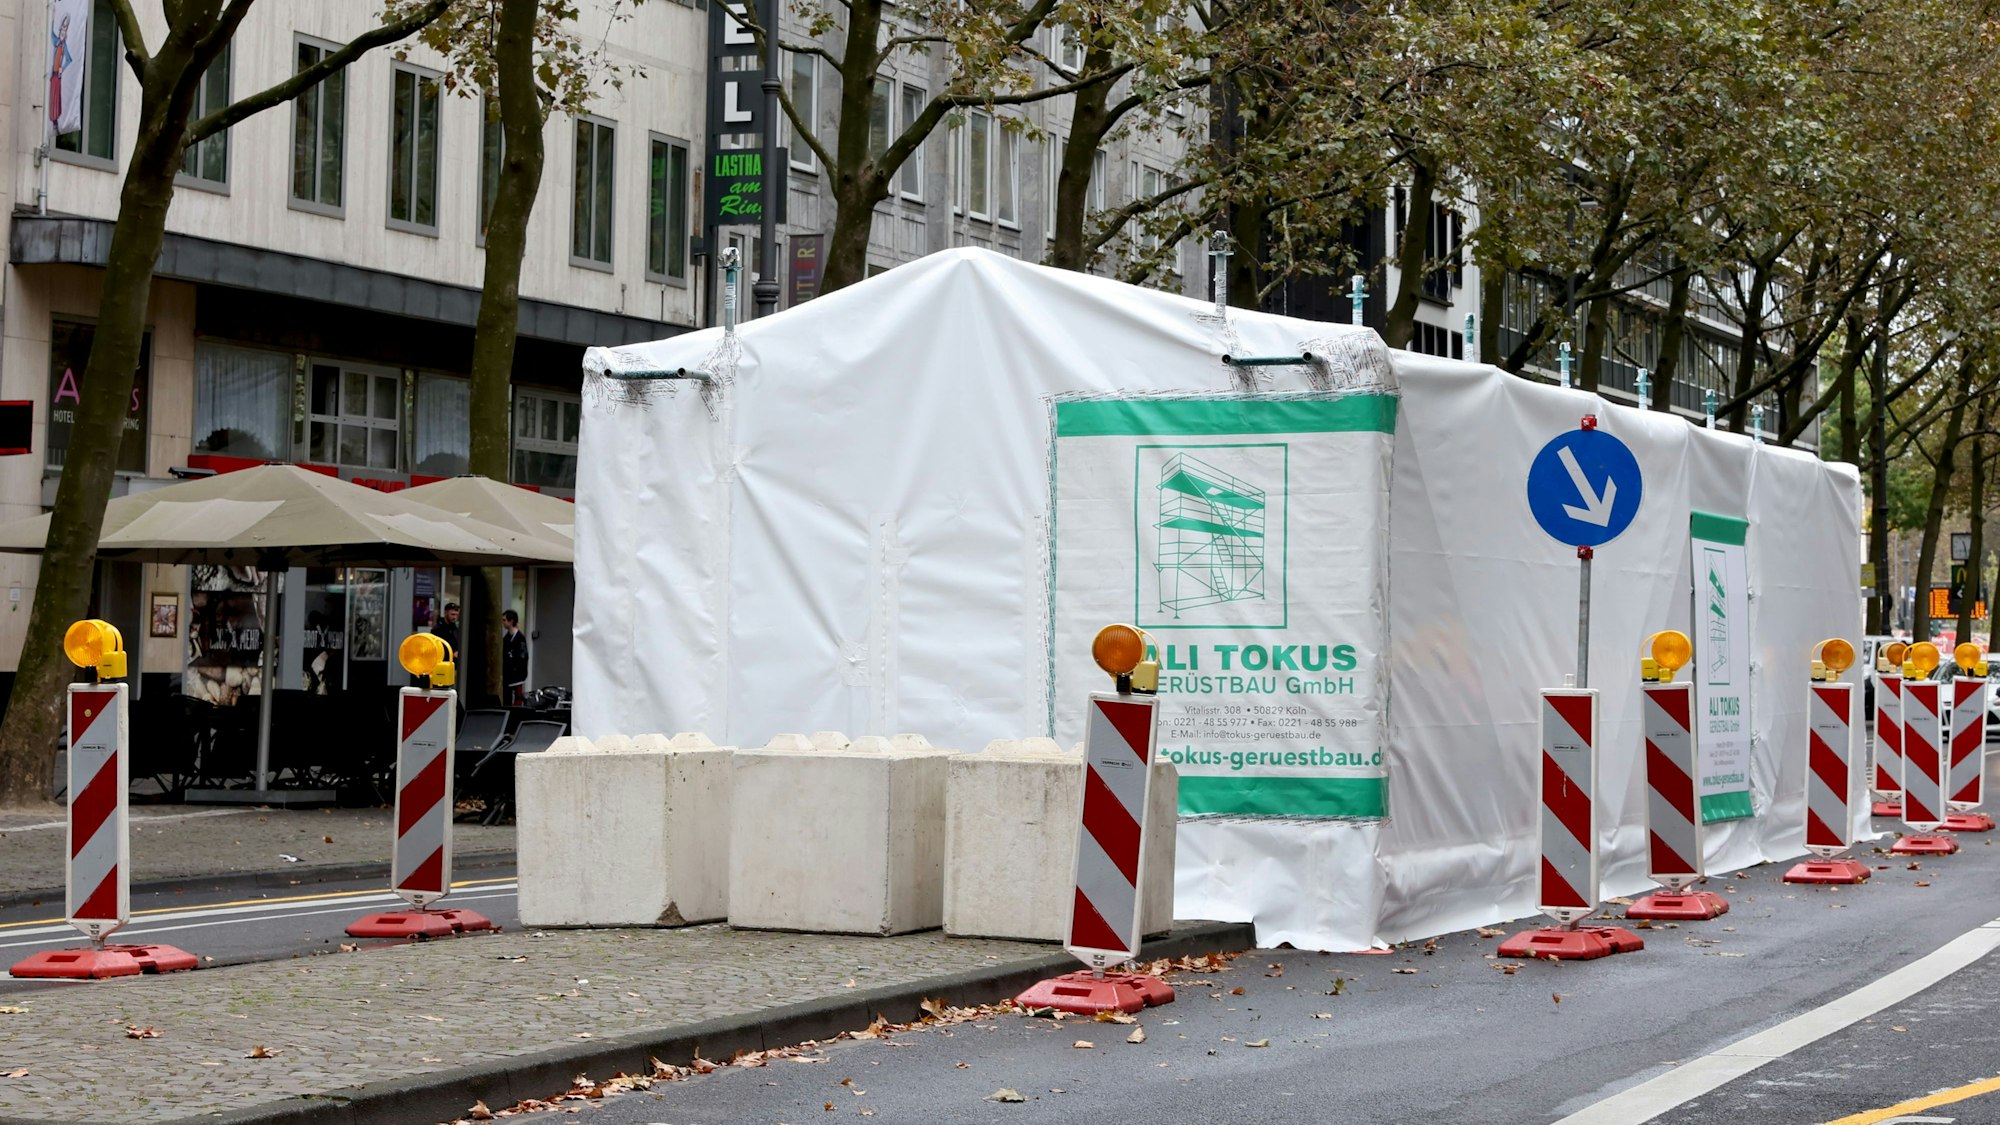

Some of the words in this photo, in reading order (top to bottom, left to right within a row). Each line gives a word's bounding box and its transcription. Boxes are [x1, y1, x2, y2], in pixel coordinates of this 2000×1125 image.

[715, 153, 762, 177] LASTHA
[729, 181, 762, 194] am
[796, 237, 816, 302] UTLERS
[53, 409, 75, 424] HOTEL
[1214, 644, 1358, 671] TOKUS
[1157, 672, 1277, 694] ERÜSTBAU
[1285, 676, 1354, 694] GmbH
[1184, 705, 1222, 715] Vitalisstr.
[1224, 705, 1241, 715] 308
[1253, 706, 1284, 715] 50829
[1286, 705, 1307, 715] Köln
[1709, 697, 1719, 716] ALI
[1720, 697, 1740, 716] TOKUS
[1173, 718, 1196, 727] 0221
[1203, 717, 1215, 727] 48
[1217, 717, 1228, 727] 55
[1230, 717, 1248, 727] 977
[1257, 718, 1276, 727] Fax:
[1278, 718, 1302, 727] 0221
[1310, 719, 1323, 727] 48
[1325, 719, 1337, 727] 55
[1339, 719, 1358, 728] 988
[1170, 729, 1202, 739] E-Mail:
[1203, 729, 1322, 741] info@tokus-geruestbau.de
[1161, 745, 1384, 771] tokus-geruestbau.d
